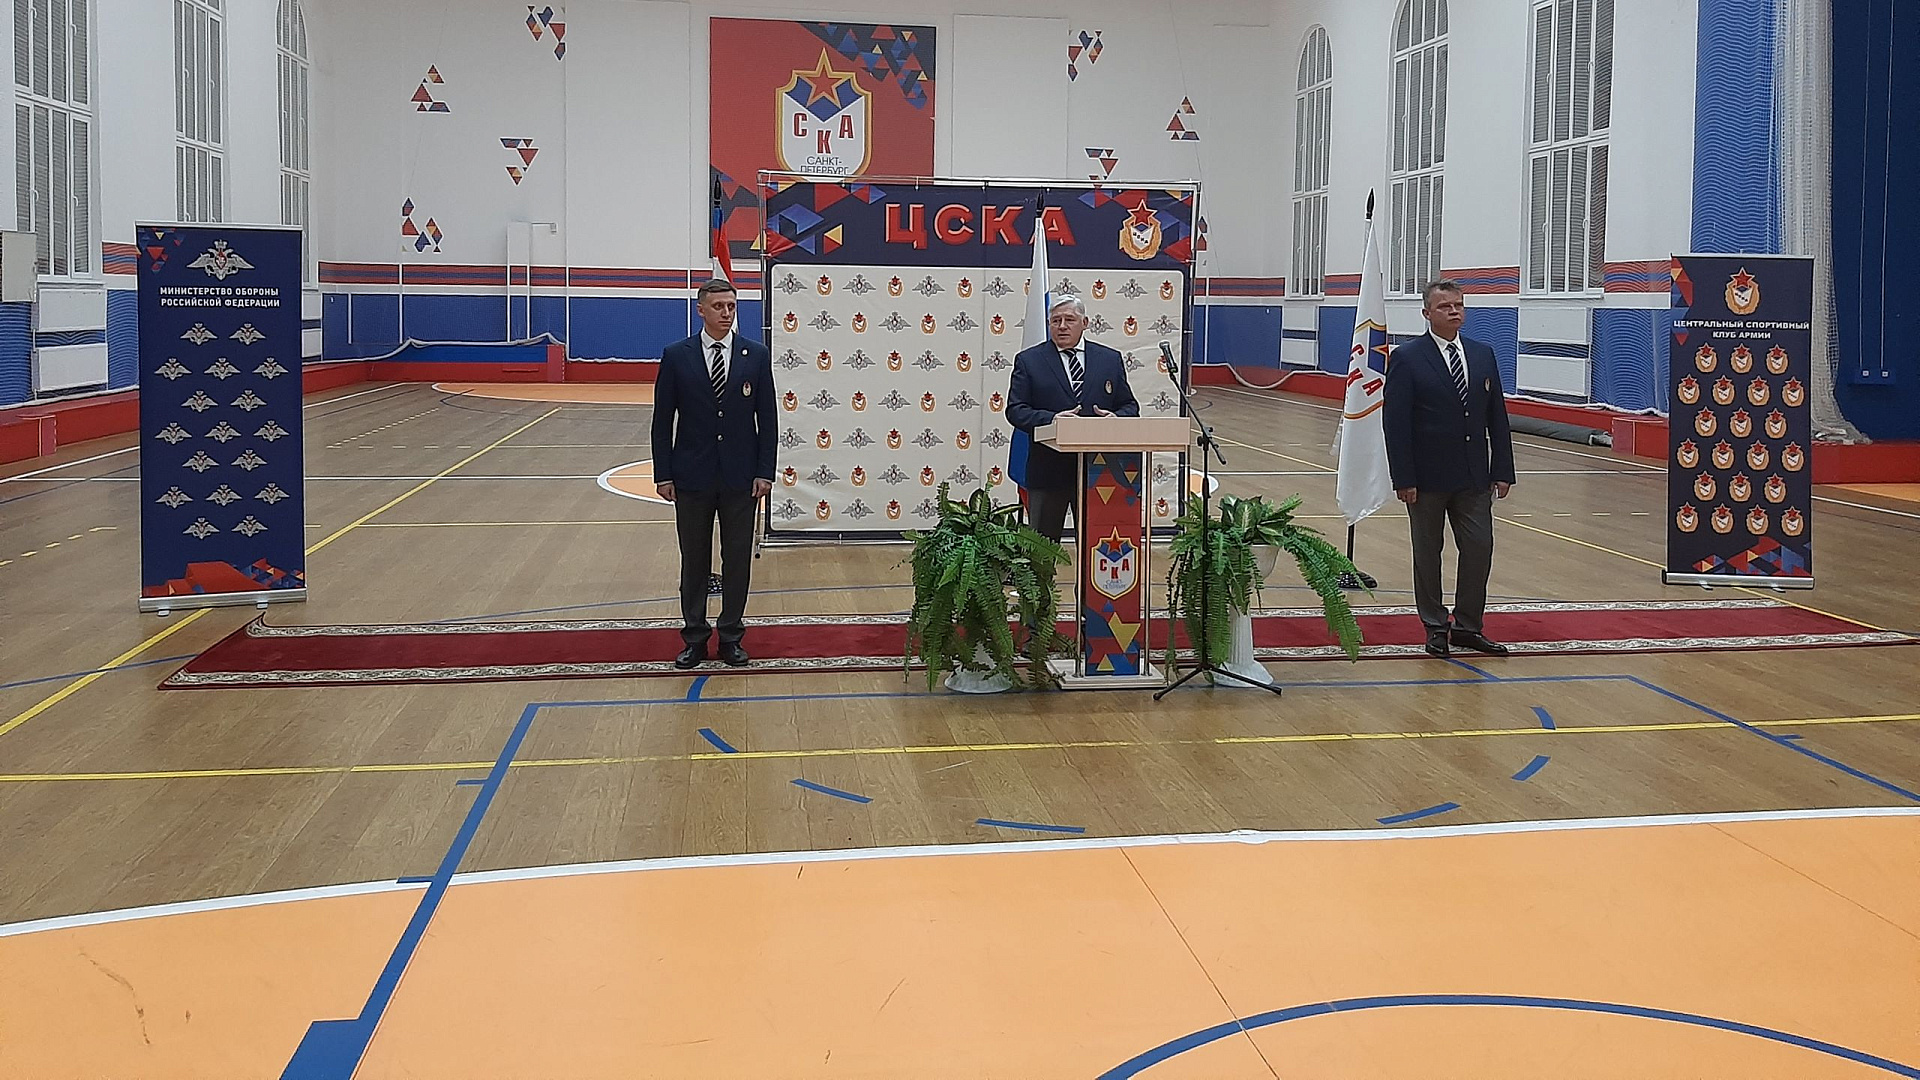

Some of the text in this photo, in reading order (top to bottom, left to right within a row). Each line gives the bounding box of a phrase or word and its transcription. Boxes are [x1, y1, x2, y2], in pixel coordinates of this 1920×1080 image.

[793, 112, 854, 154] СКА
[806, 156, 842, 166] САНКТ-
[885, 203, 1076, 249] ЦСКА
[160, 286, 279, 296] МИНИСТЕРСТВО ОБОРОНЫ
[161, 297, 280, 308] РОССИЙСКОЙ ФЕДЕРАЦИИ
[1673, 320, 1810, 330] ЦЕНТРАЛЬНЫЙ СПОРТИВНЫЙ
[1712, 331, 1771, 340] КЛУБ АРМИИ
[1099, 558, 1130, 580] СКА
